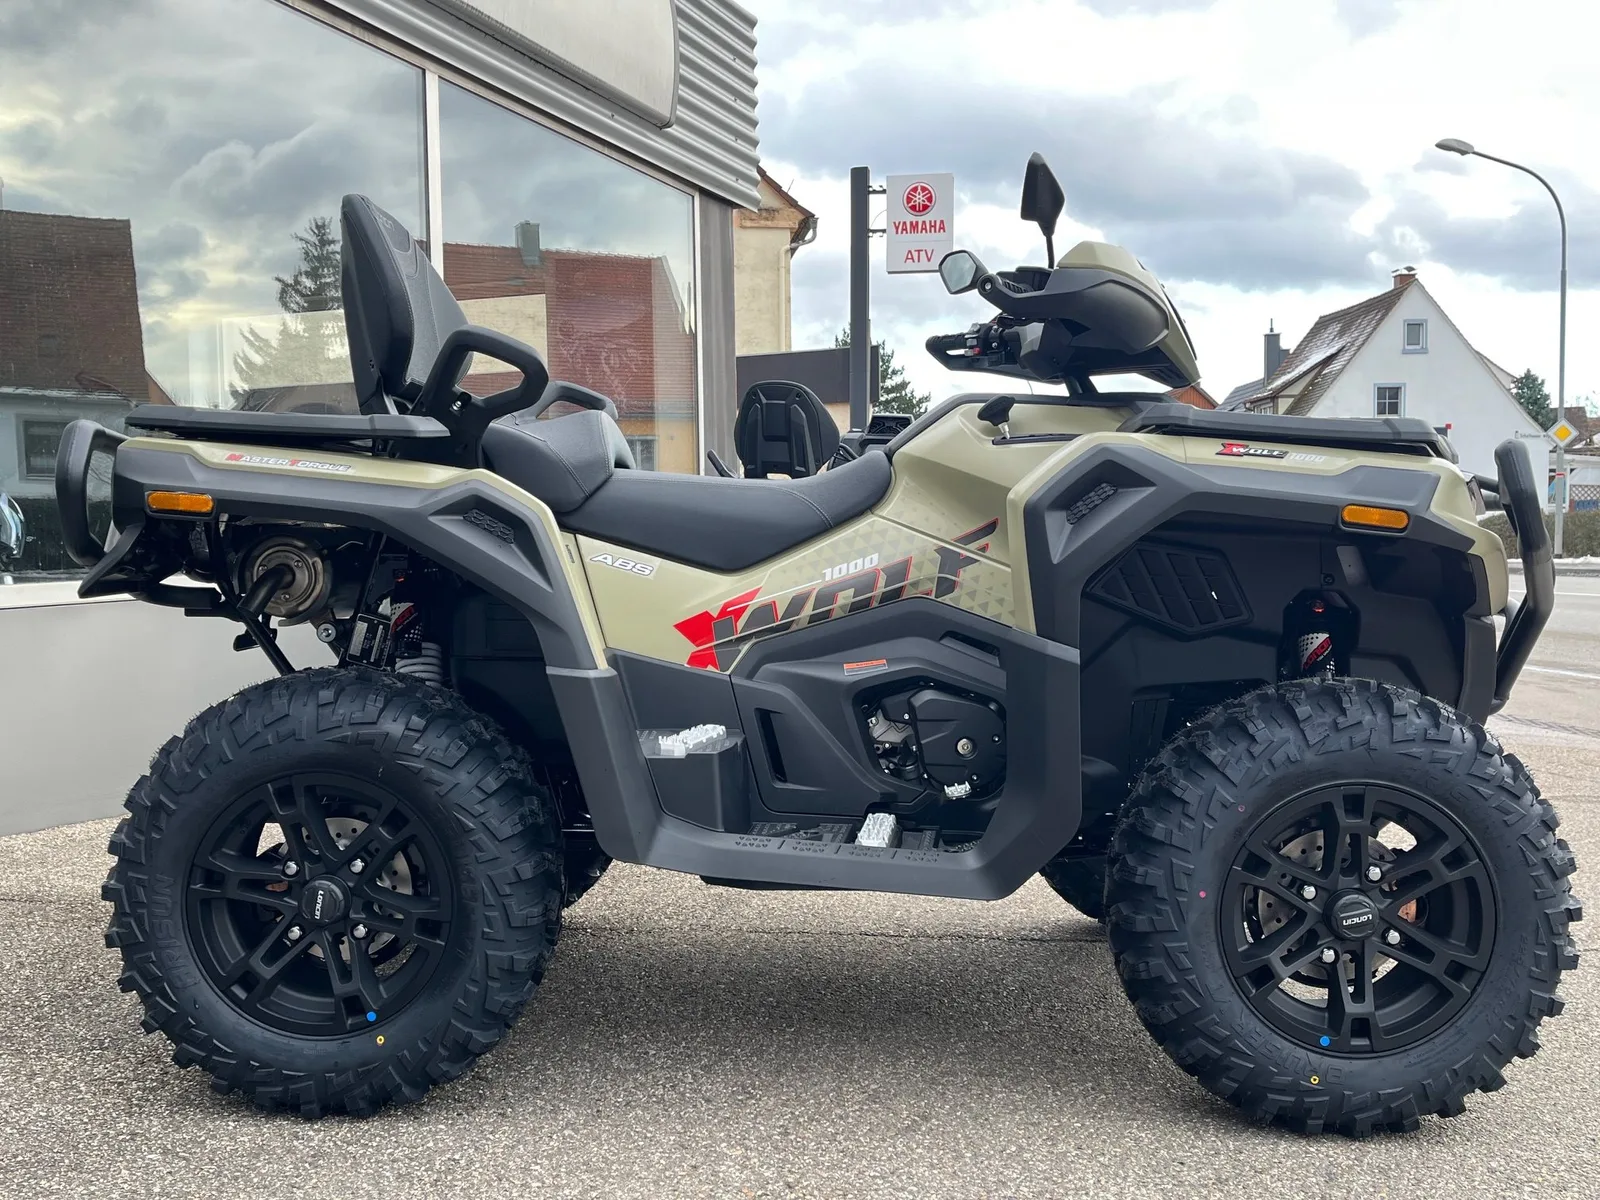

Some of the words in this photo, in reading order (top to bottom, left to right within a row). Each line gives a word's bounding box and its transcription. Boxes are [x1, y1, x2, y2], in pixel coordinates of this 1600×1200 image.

[893, 219, 946, 234] YAMAHA
[904, 249, 934, 263] ATV
[1288, 452, 1326, 462] 1000
[590, 552, 654, 576] ABS
[822, 552, 879, 581] 1000
